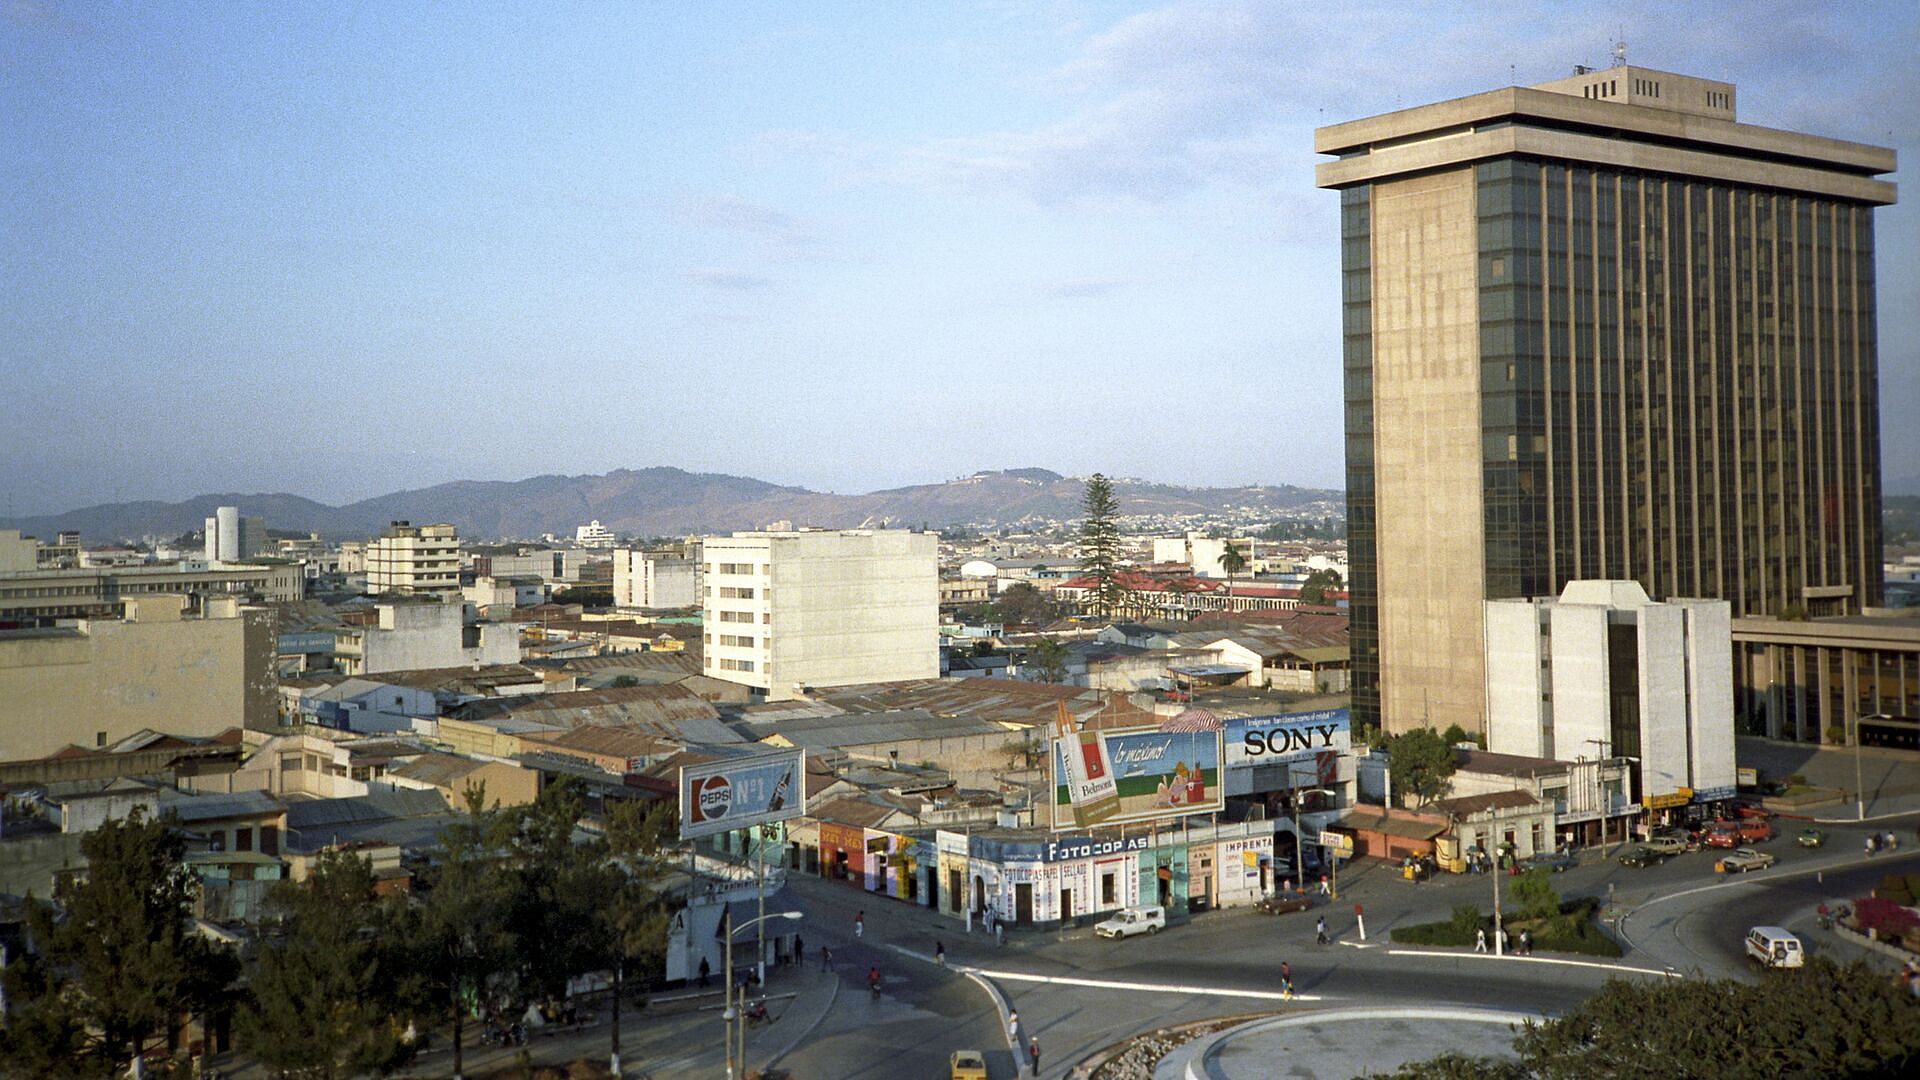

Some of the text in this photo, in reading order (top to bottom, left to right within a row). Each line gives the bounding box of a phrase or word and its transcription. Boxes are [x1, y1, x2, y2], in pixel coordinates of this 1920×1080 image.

[1244, 724, 1338, 755] SONY
[1081, 780, 1112, 797] Belmont
[701, 789, 731, 806] PEPSI
[1049, 838, 1147, 861] FOTOCOPAS
[1226, 839, 1273, 852] IMPRENTA
[1005, 867, 1042, 881] FOTOCOPIAS
